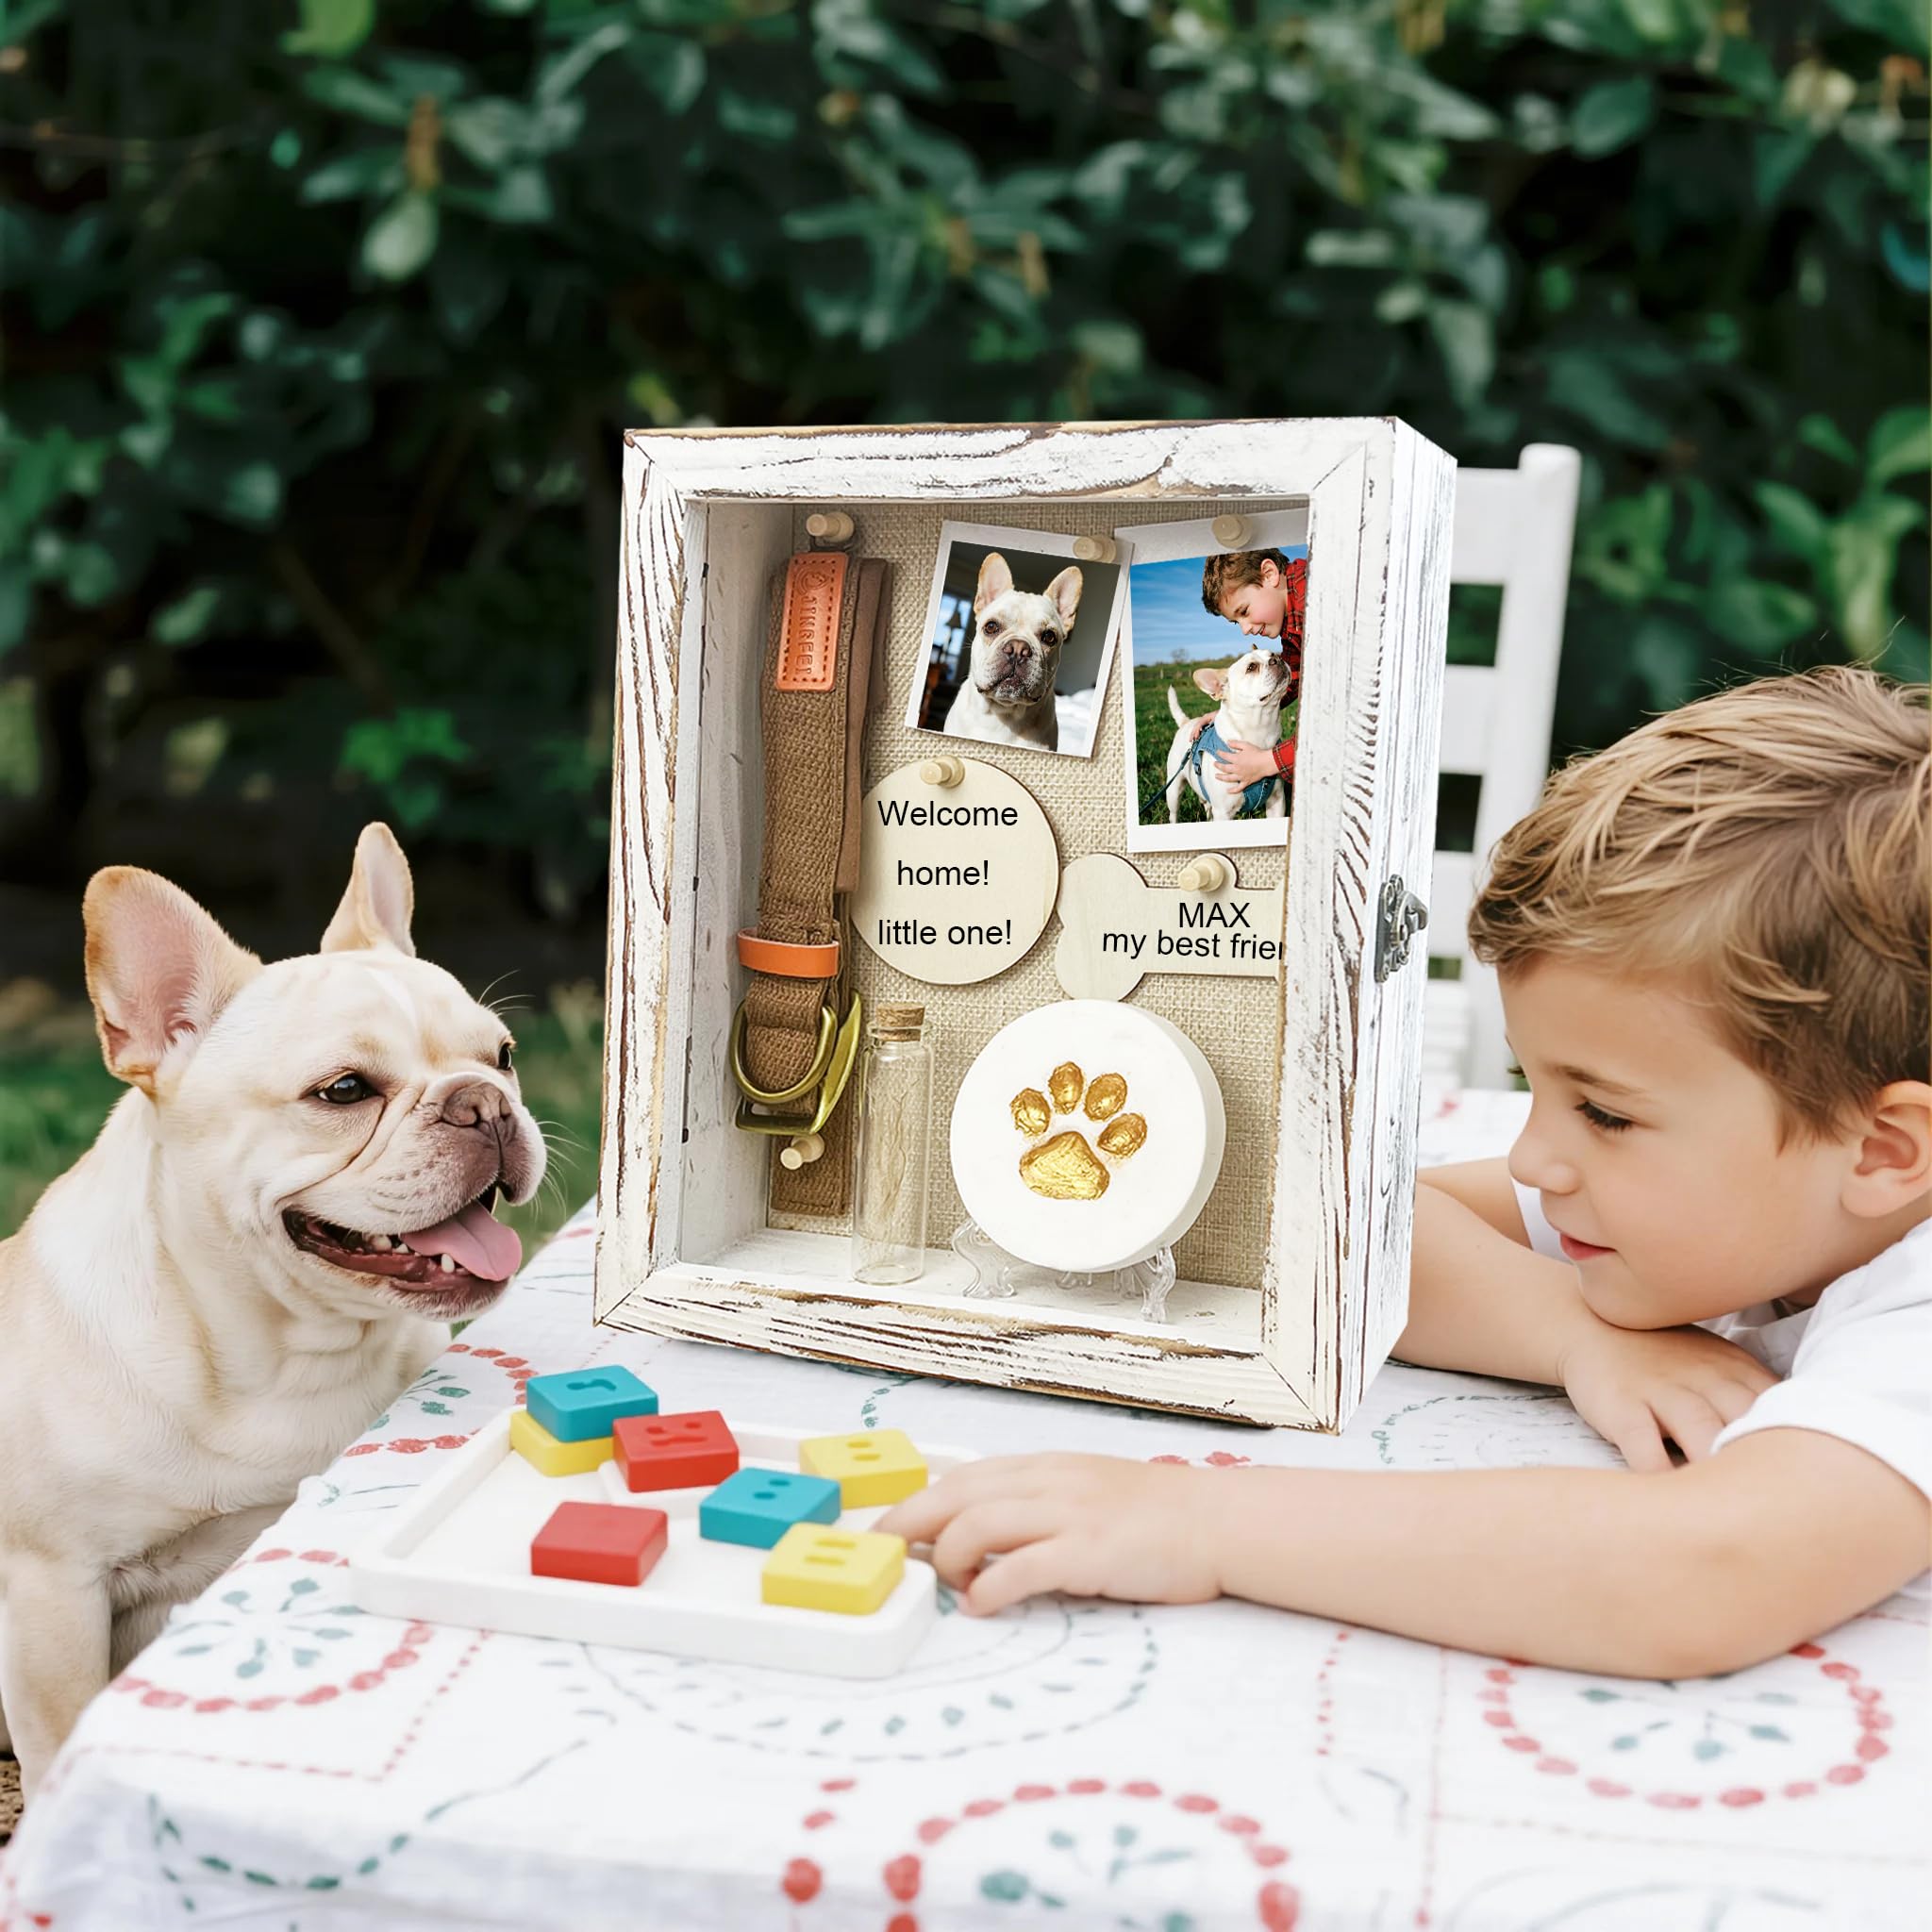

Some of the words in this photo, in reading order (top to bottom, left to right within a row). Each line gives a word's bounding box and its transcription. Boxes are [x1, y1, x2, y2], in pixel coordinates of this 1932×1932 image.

[877, 800, 1018, 826] Welcome
[897, 859, 989, 886] home!
[1179, 902, 1251, 928] MAX
[878, 919, 937, 945] little
[947, 919, 1011, 945] one!
[1103, 933, 1147, 959] my
[1158, 929, 1221, 958] best
[1230, 932, 1284, 960] frie
